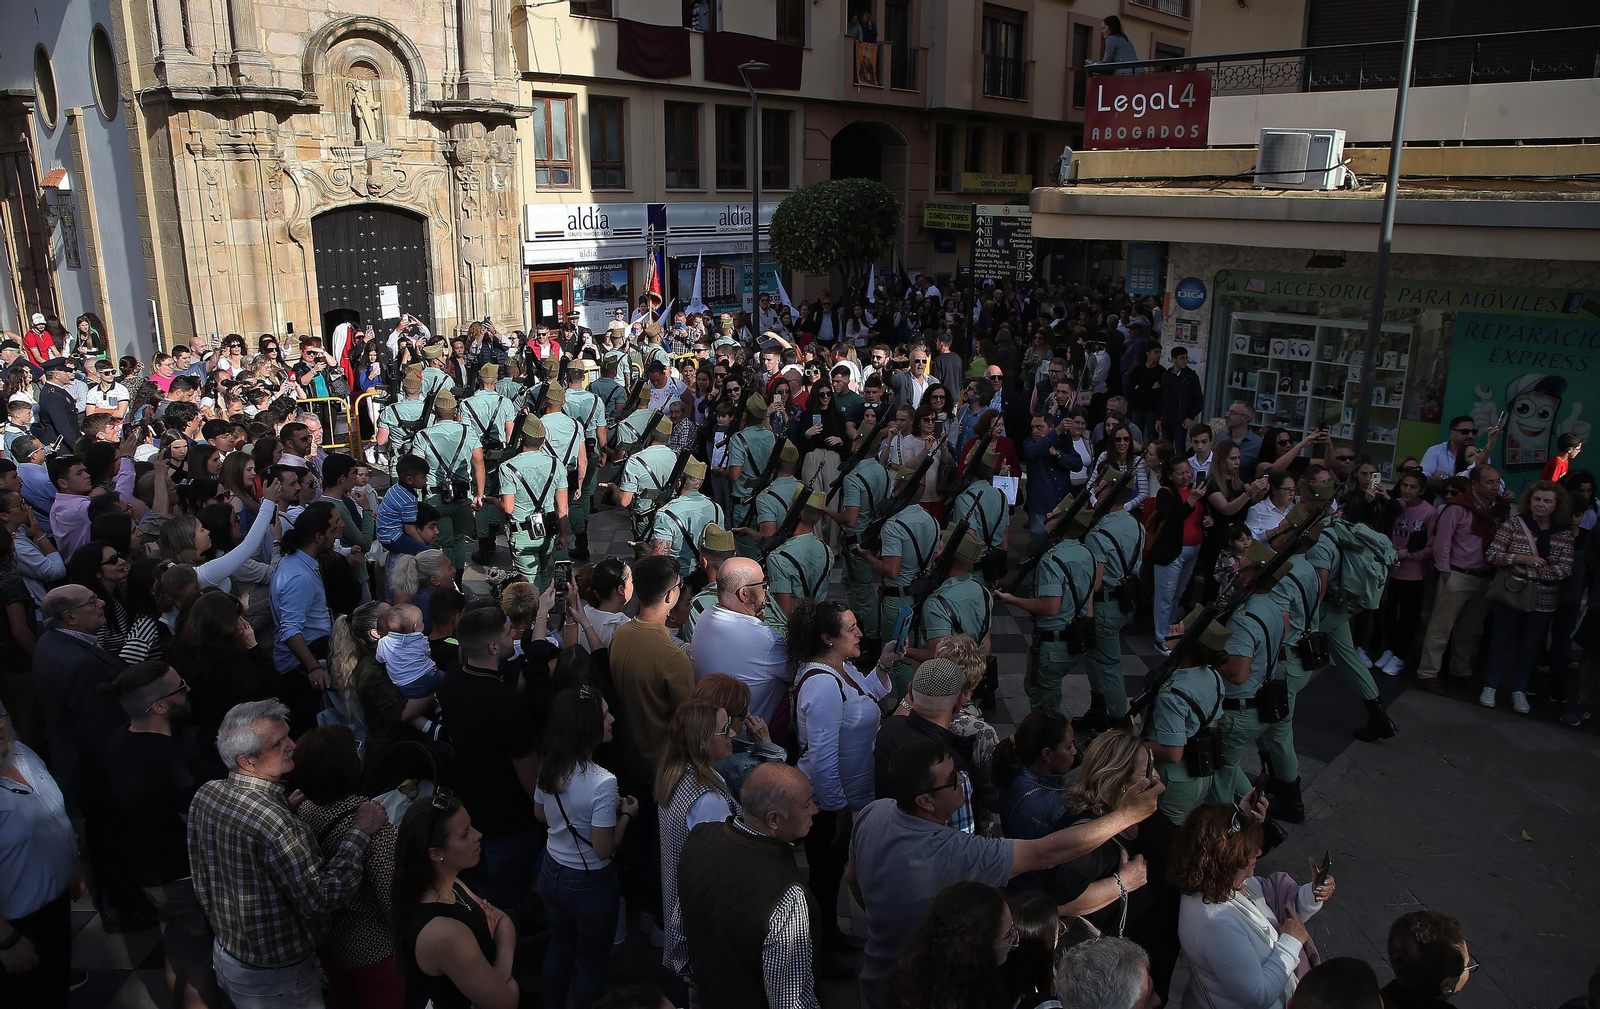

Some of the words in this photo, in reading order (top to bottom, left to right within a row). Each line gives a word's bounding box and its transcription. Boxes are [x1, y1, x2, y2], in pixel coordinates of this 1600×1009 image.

[1097, 83, 1196, 118] Legal4
[1091, 124, 1199, 140] ABOGADOS
[567, 206, 610, 231] aldía
[719, 204, 752, 226] aldía
[929, 212, 969, 221] CONDUCTORES
[1177, 290, 1204, 299] DIGI
[1397, 287, 1451, 306] PARA
[1460, 289, 1561, 313] MÓVILES
[1489, 347, 1591, 372] EXPRESS
